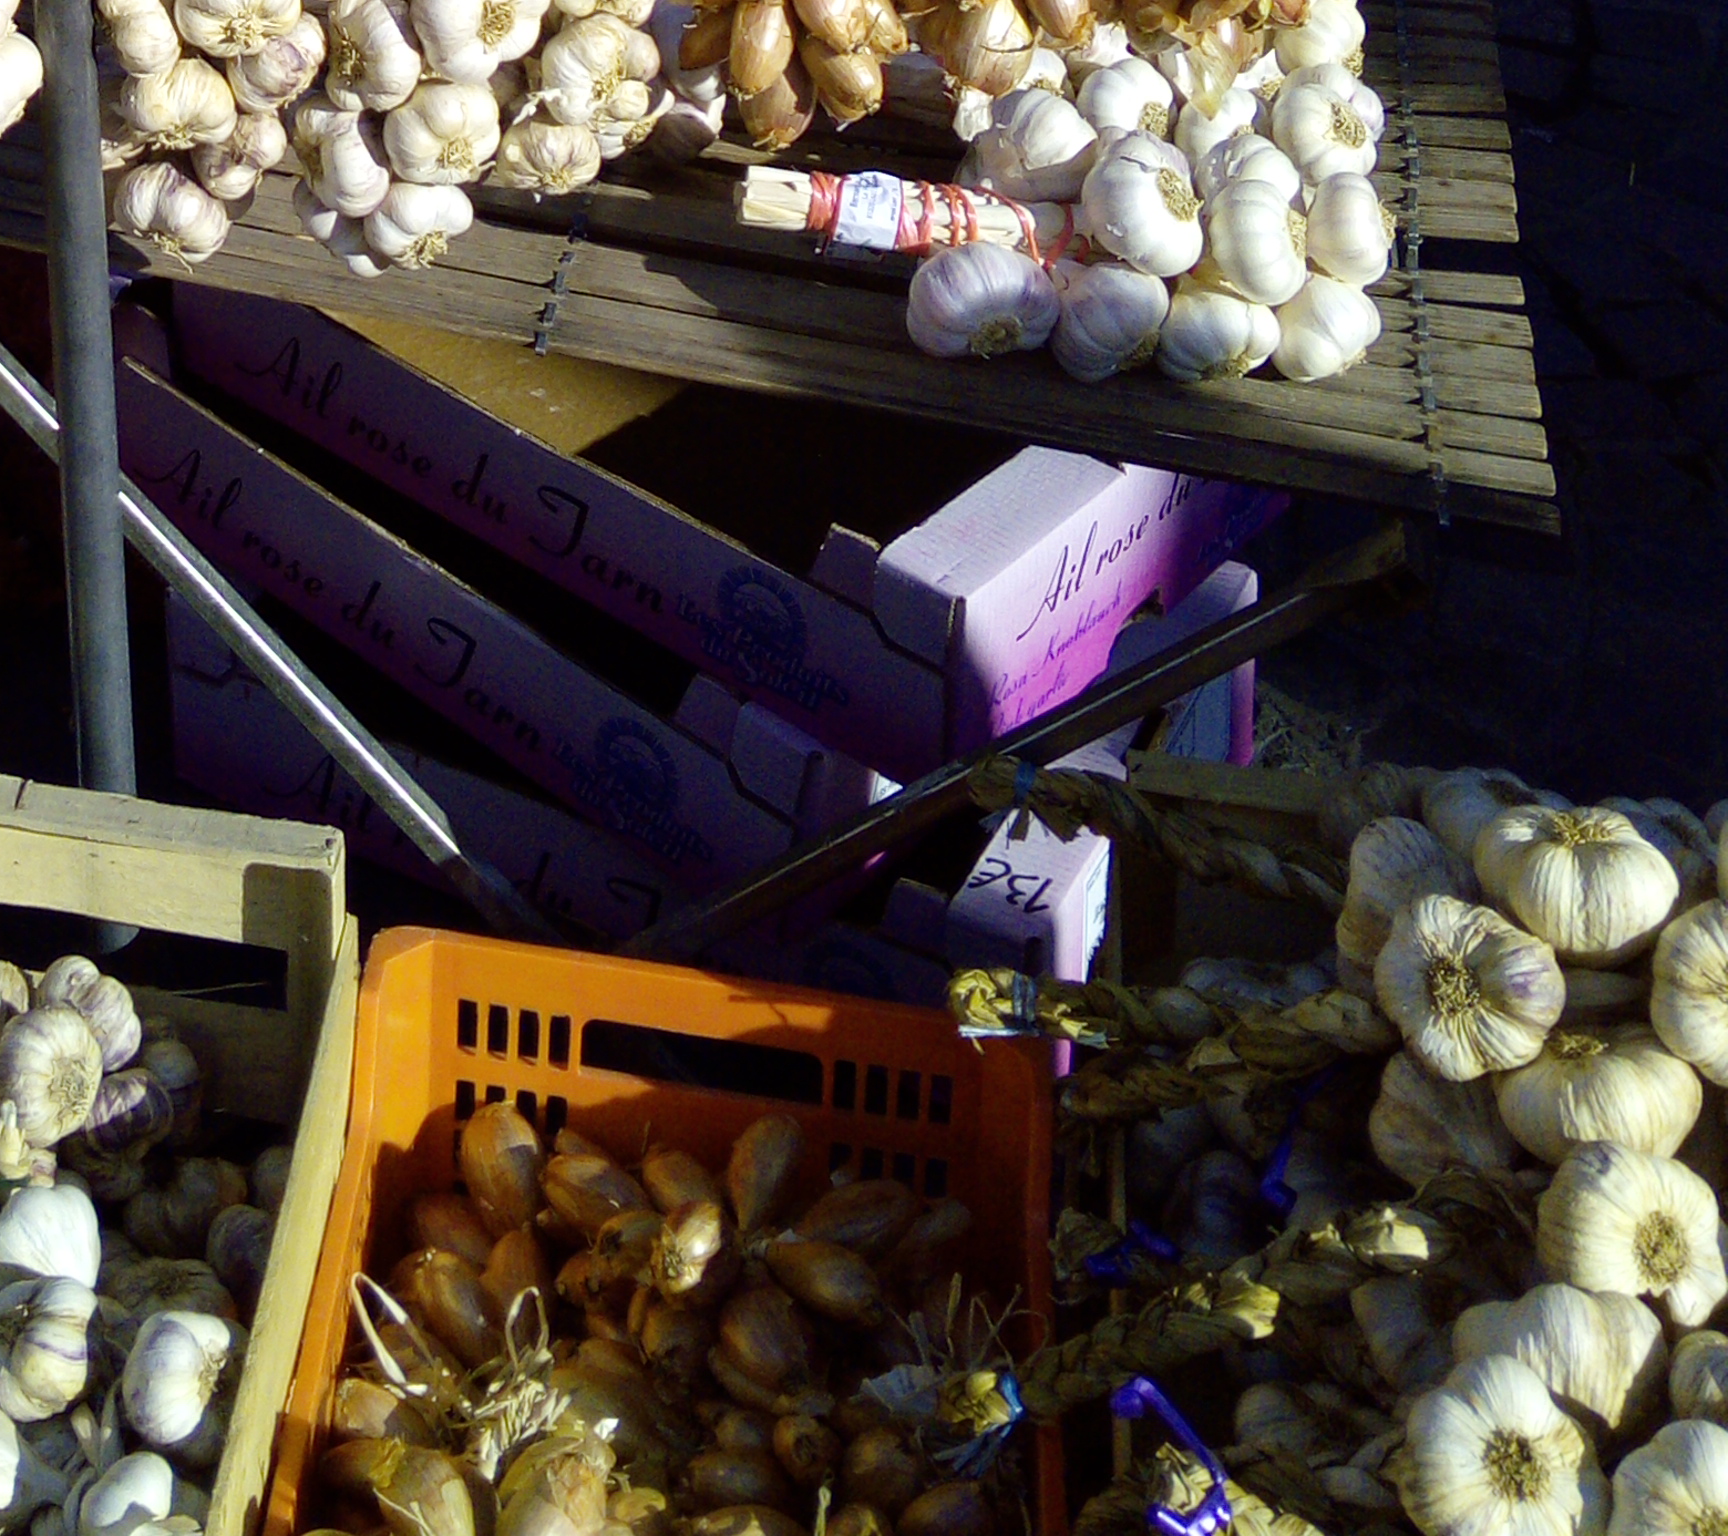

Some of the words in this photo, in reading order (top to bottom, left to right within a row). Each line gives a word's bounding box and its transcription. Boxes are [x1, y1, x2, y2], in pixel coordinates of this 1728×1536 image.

[133, 449, 243, 529] Ail
[242, 530, 323, 594] rose
[341, 581, 396, 649] du
[413, 617, 541, 752] Tarn
[234, 337, 343, 420] Ail
[347, 415, 433, 479] rose
[452, 453, 509, 525] du
[528, 484, 665, 616] Tarn
[1016, 520, 1099, 643] Ail
[1095, 514, 1151, 577] rose
